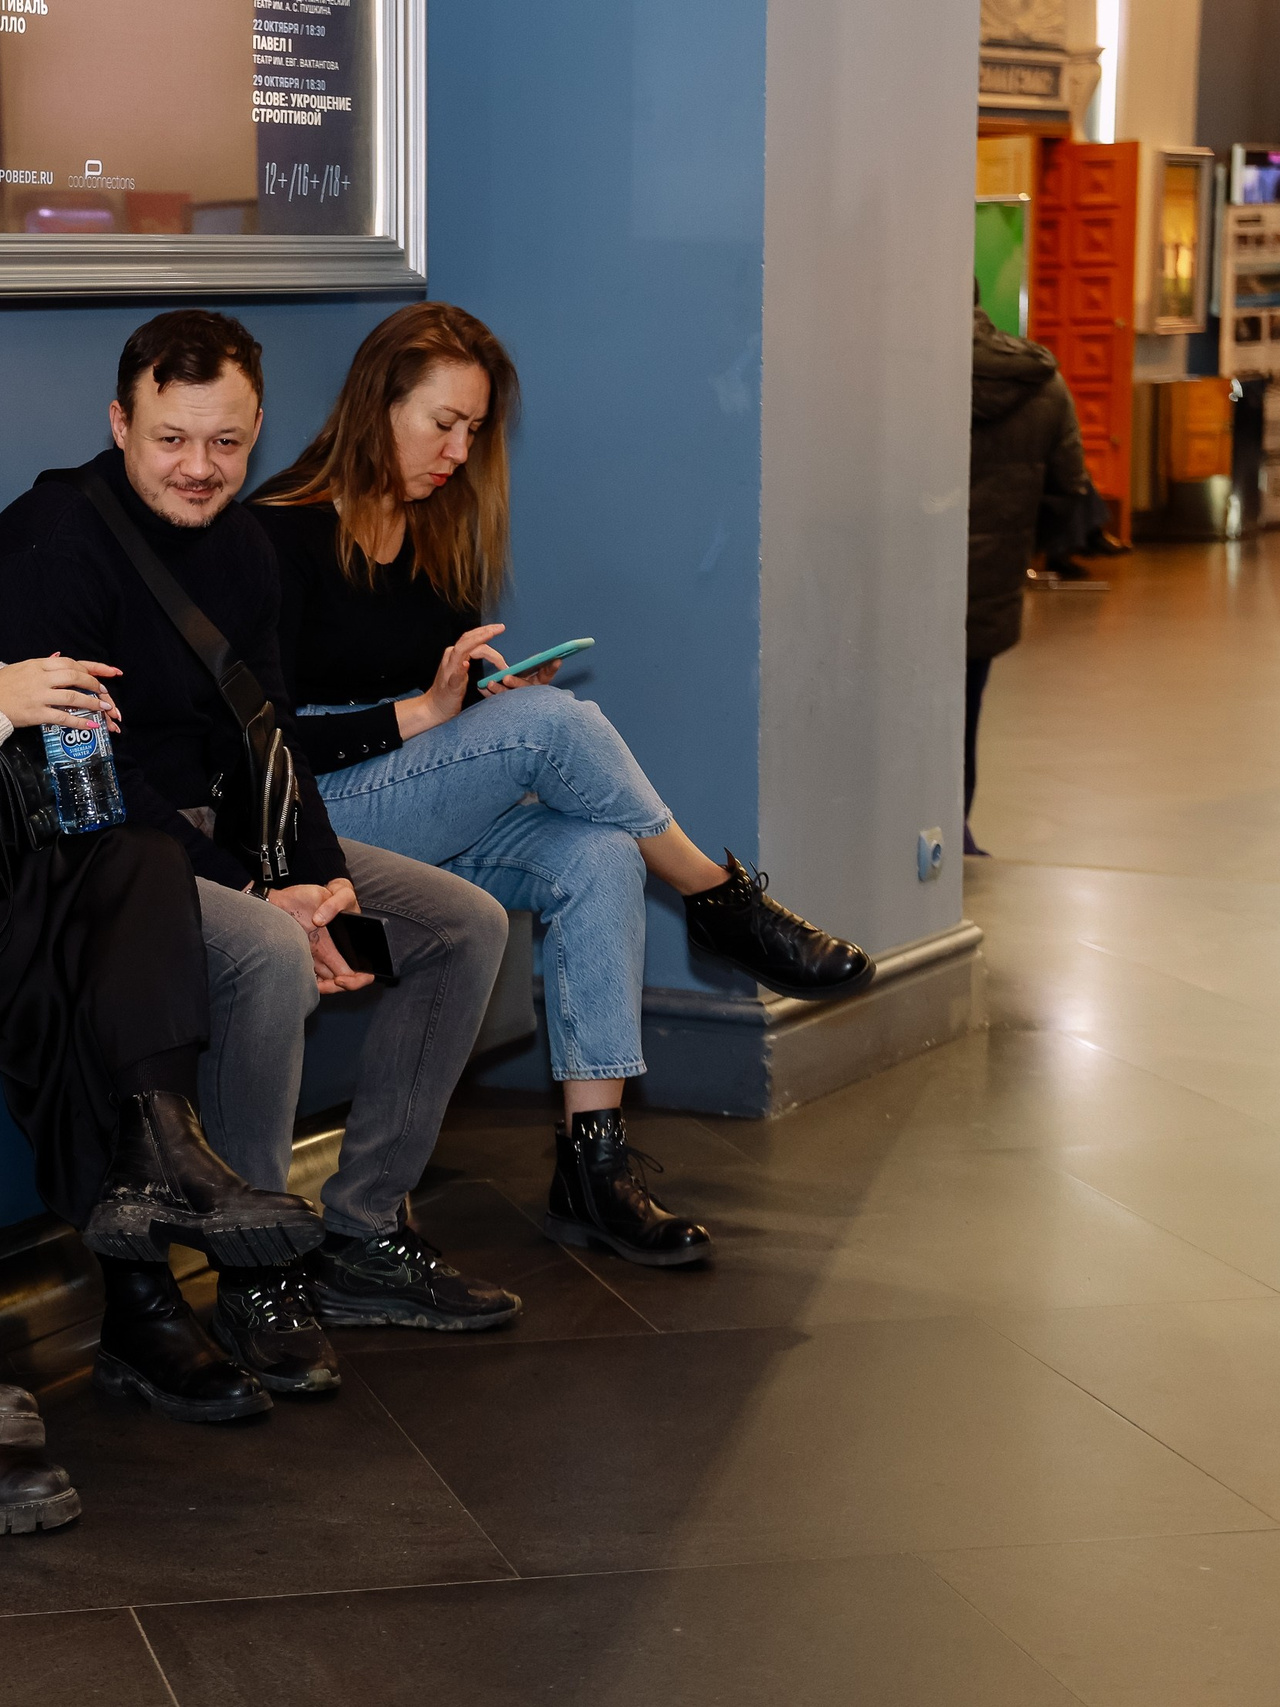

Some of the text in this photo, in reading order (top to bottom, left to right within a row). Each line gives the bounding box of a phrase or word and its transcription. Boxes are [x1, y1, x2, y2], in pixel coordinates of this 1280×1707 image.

[252, 19, 262, 31] 22
[264, 20, 299, 34] ОКТЯБРЯ
[252, 35, 287, 52] ПАВЕЛ
[253, 54, 273, 65] ТЕАТР
[252, 74, 262, 87] 29
[264, 75, 299, 89] ОКТЯБРЯ
[252, 90, 352, 112] GLOBE: УКРОЩЕНИЕ
[252, 107, 322, 126] СТРОПТИВОЙ
[65, 729, 91, 745] dio
[72, 750, 90, 758] WATER
